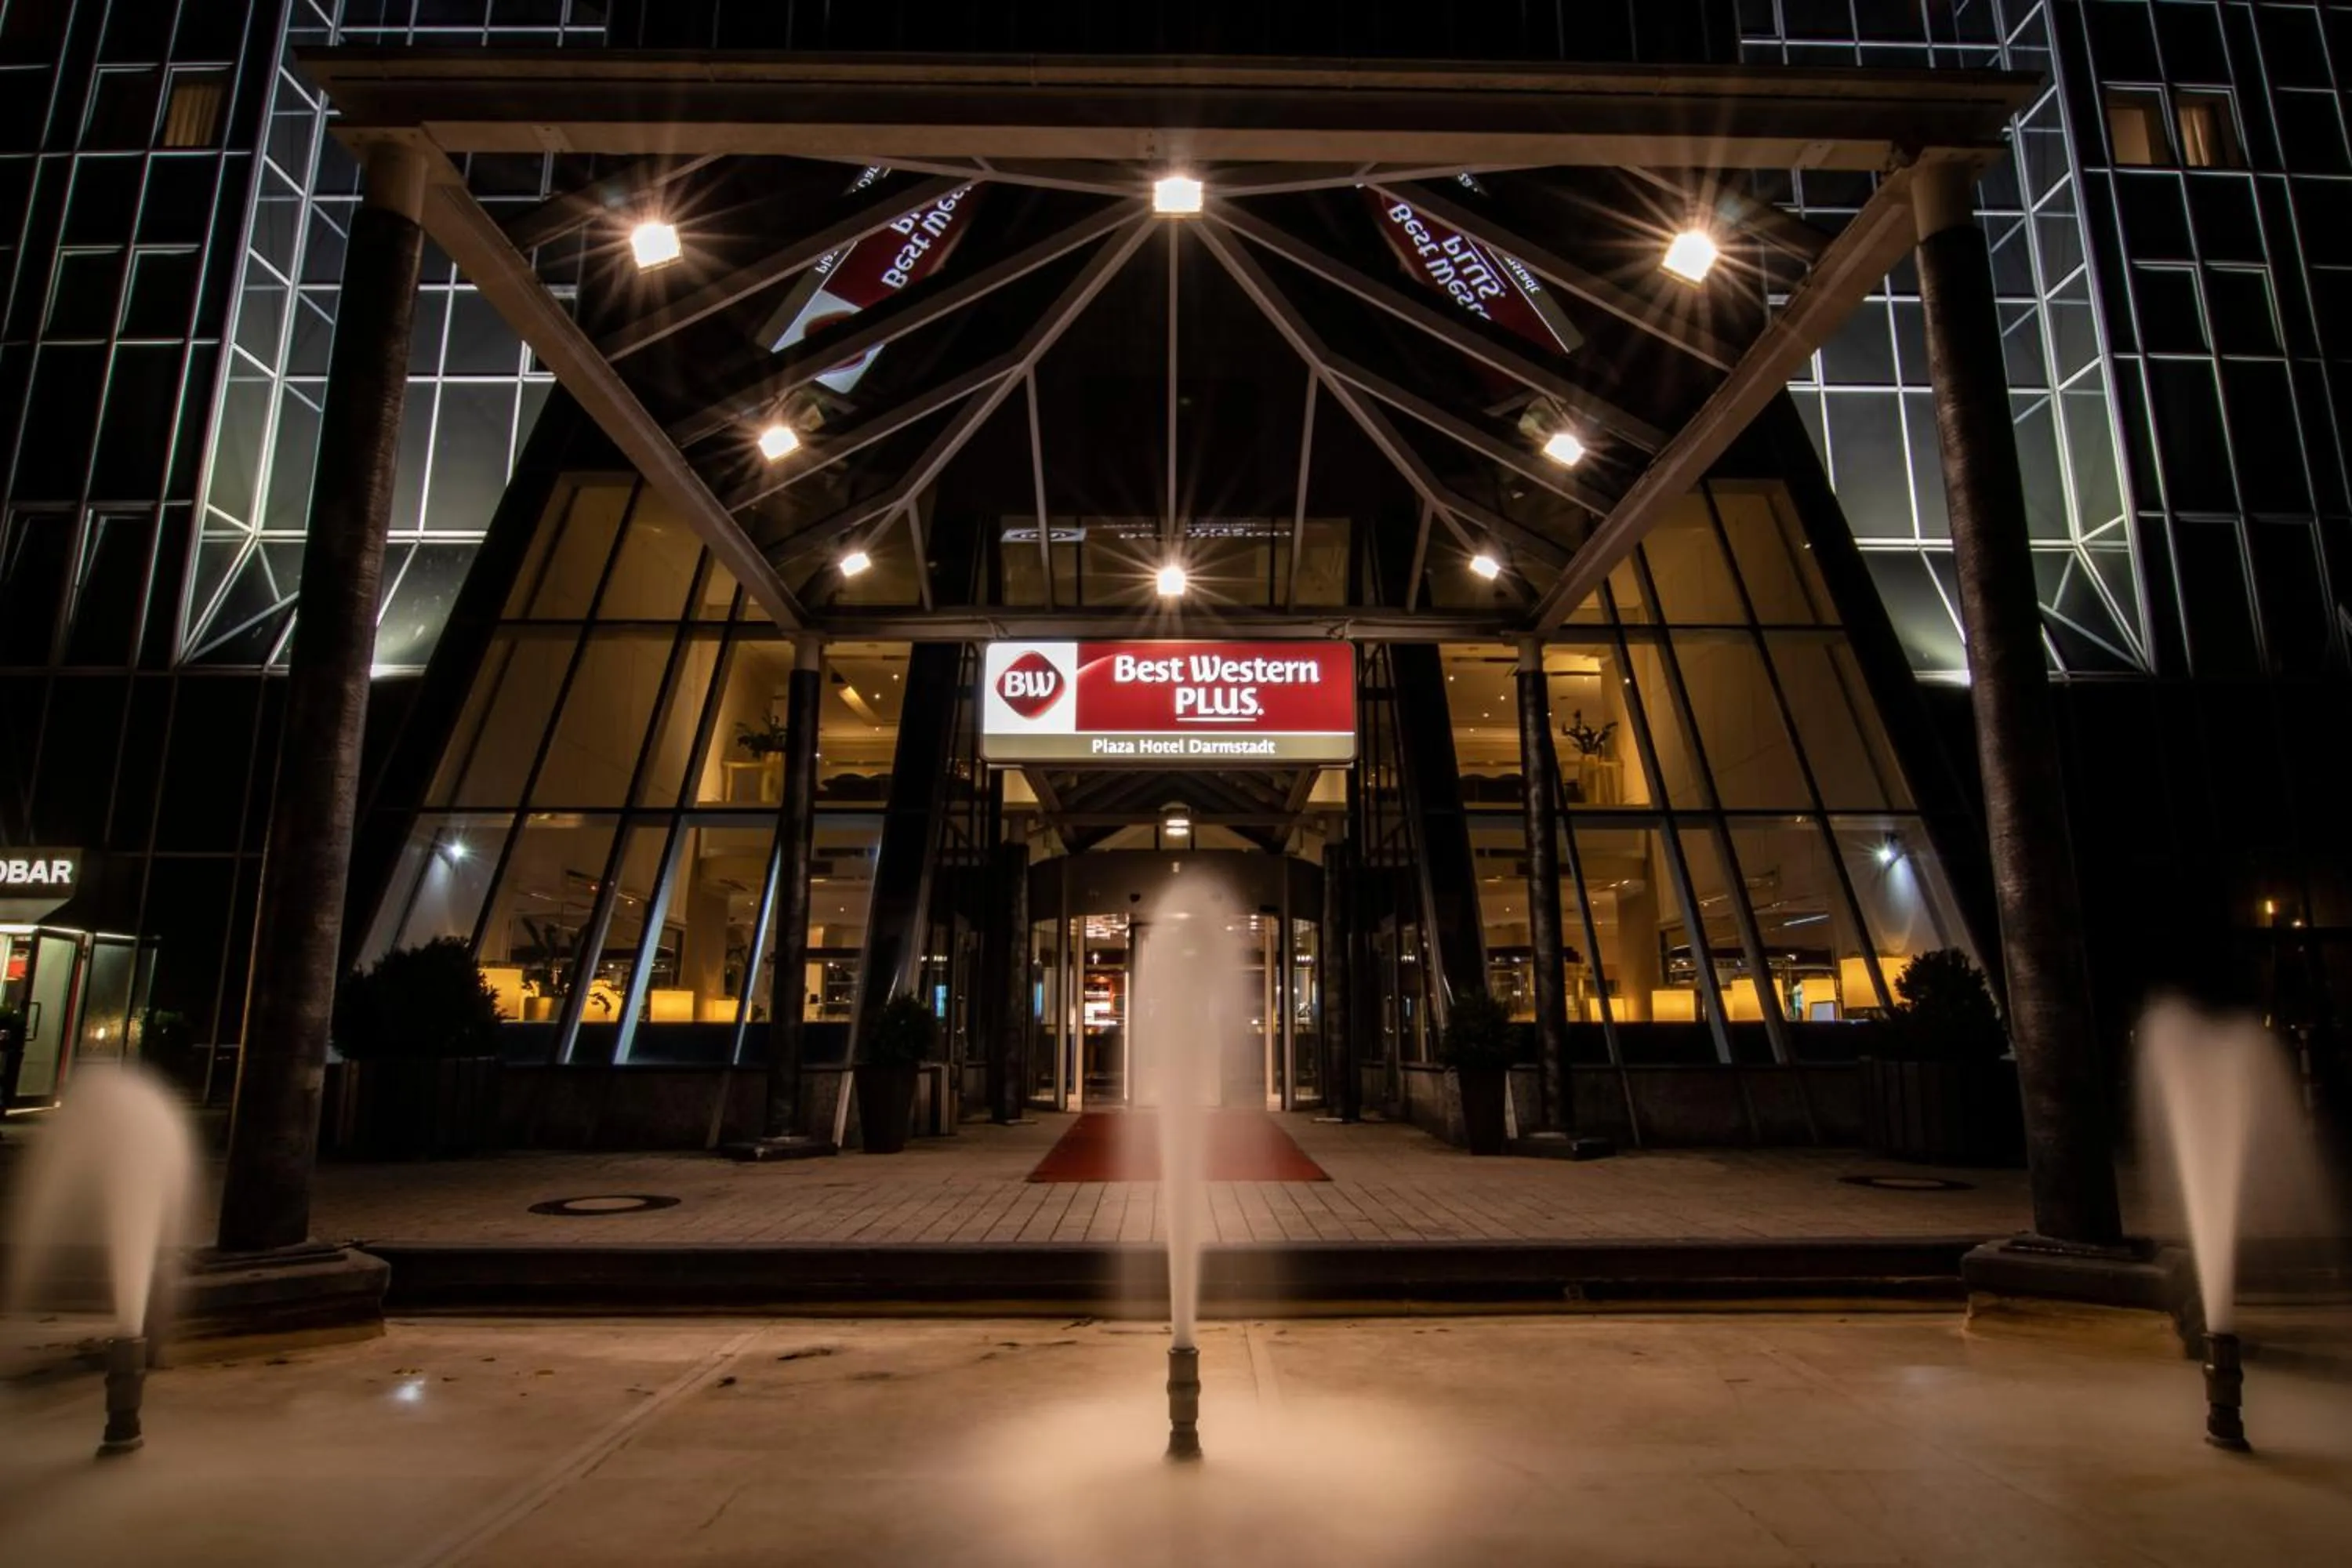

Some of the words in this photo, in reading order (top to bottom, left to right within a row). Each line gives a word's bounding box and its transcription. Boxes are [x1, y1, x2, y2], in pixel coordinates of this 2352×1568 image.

[1114, 655, 1184, 682] Best
[1189, 655, 1320, 683] Western
[1004, 670, 1056, 697] BW
[1091, 739, 1134, 753] Plaza
[1139, 739, 1184, 753] Hotel
[1189, 739, 1275, 754] Darmstadt
